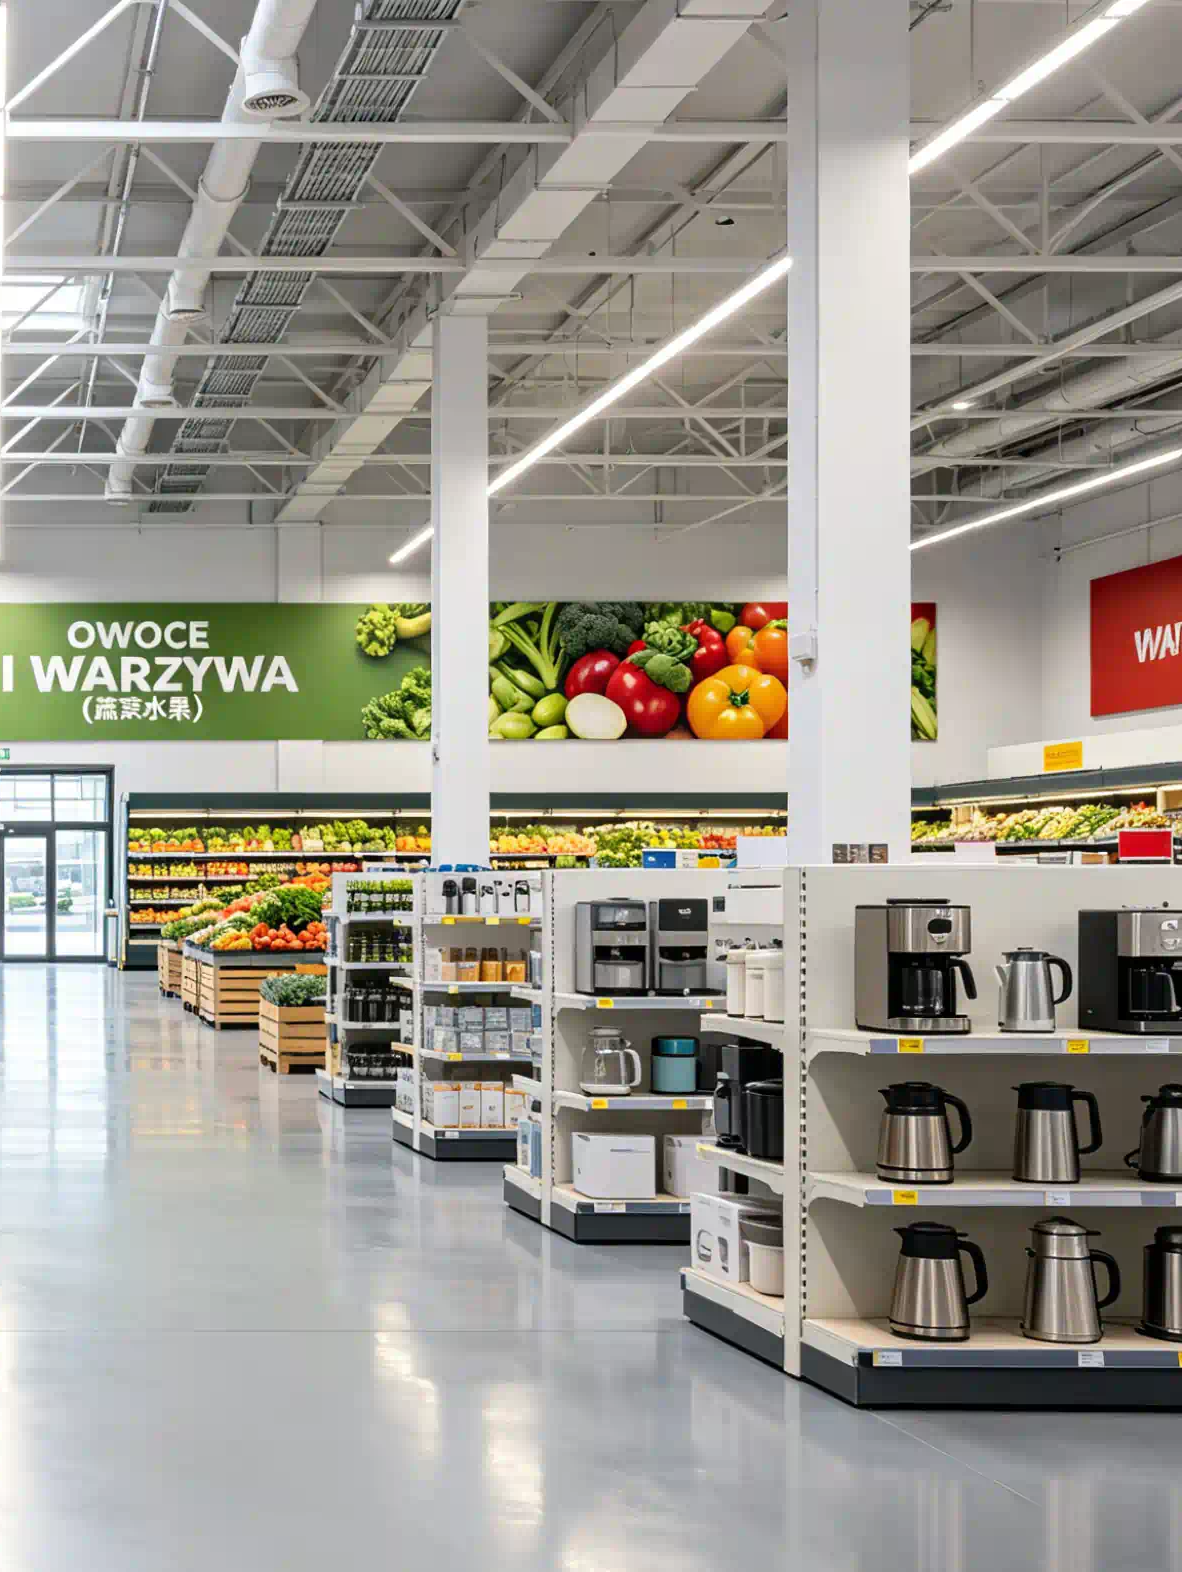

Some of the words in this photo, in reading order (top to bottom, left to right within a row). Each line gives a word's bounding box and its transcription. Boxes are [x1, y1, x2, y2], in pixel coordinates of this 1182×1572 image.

[67, 620, 210, 650] OWOCE
[2, 655, 15, 692] I
[29, 655, 299, 693] WARZYWA
